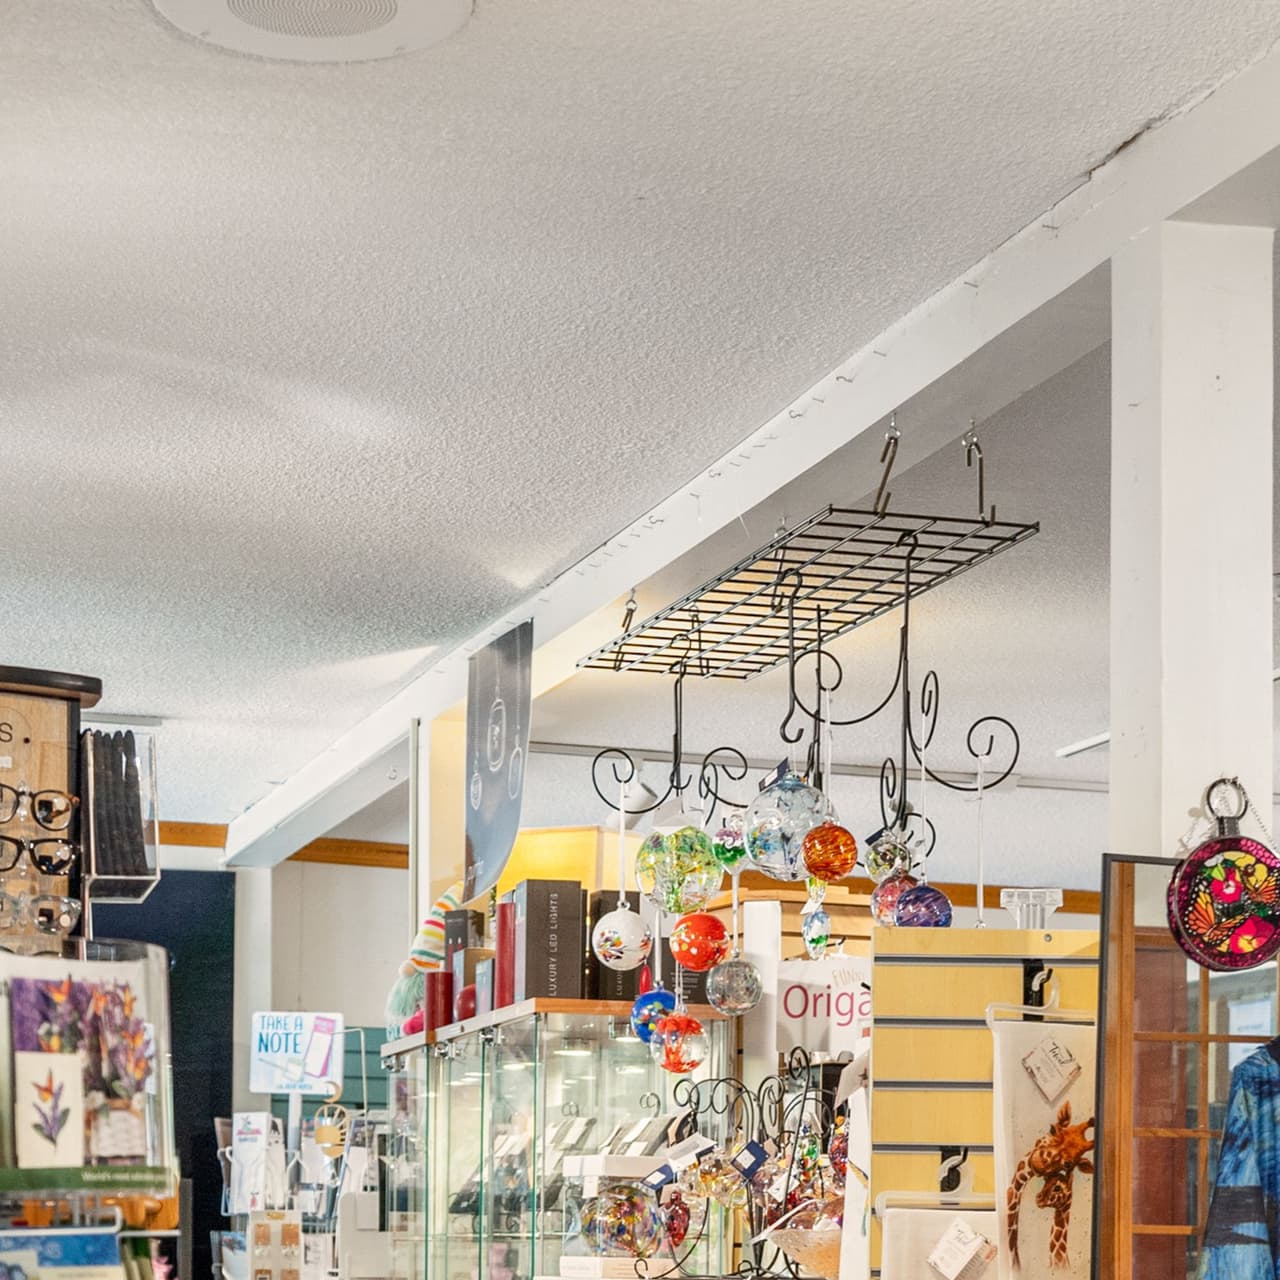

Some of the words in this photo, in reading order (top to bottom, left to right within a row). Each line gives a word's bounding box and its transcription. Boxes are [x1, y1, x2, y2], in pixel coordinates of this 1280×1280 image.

[549, 892, 559, 929] LIGHTS
[549, 935, 558, 953] LED
[548, 958, 558, 997] LUXURY
[259, 1015, 290, 1031] TAKE
[294, 1015, 303, 1031] A
[257, 1031, 303, 1054] NOTE
